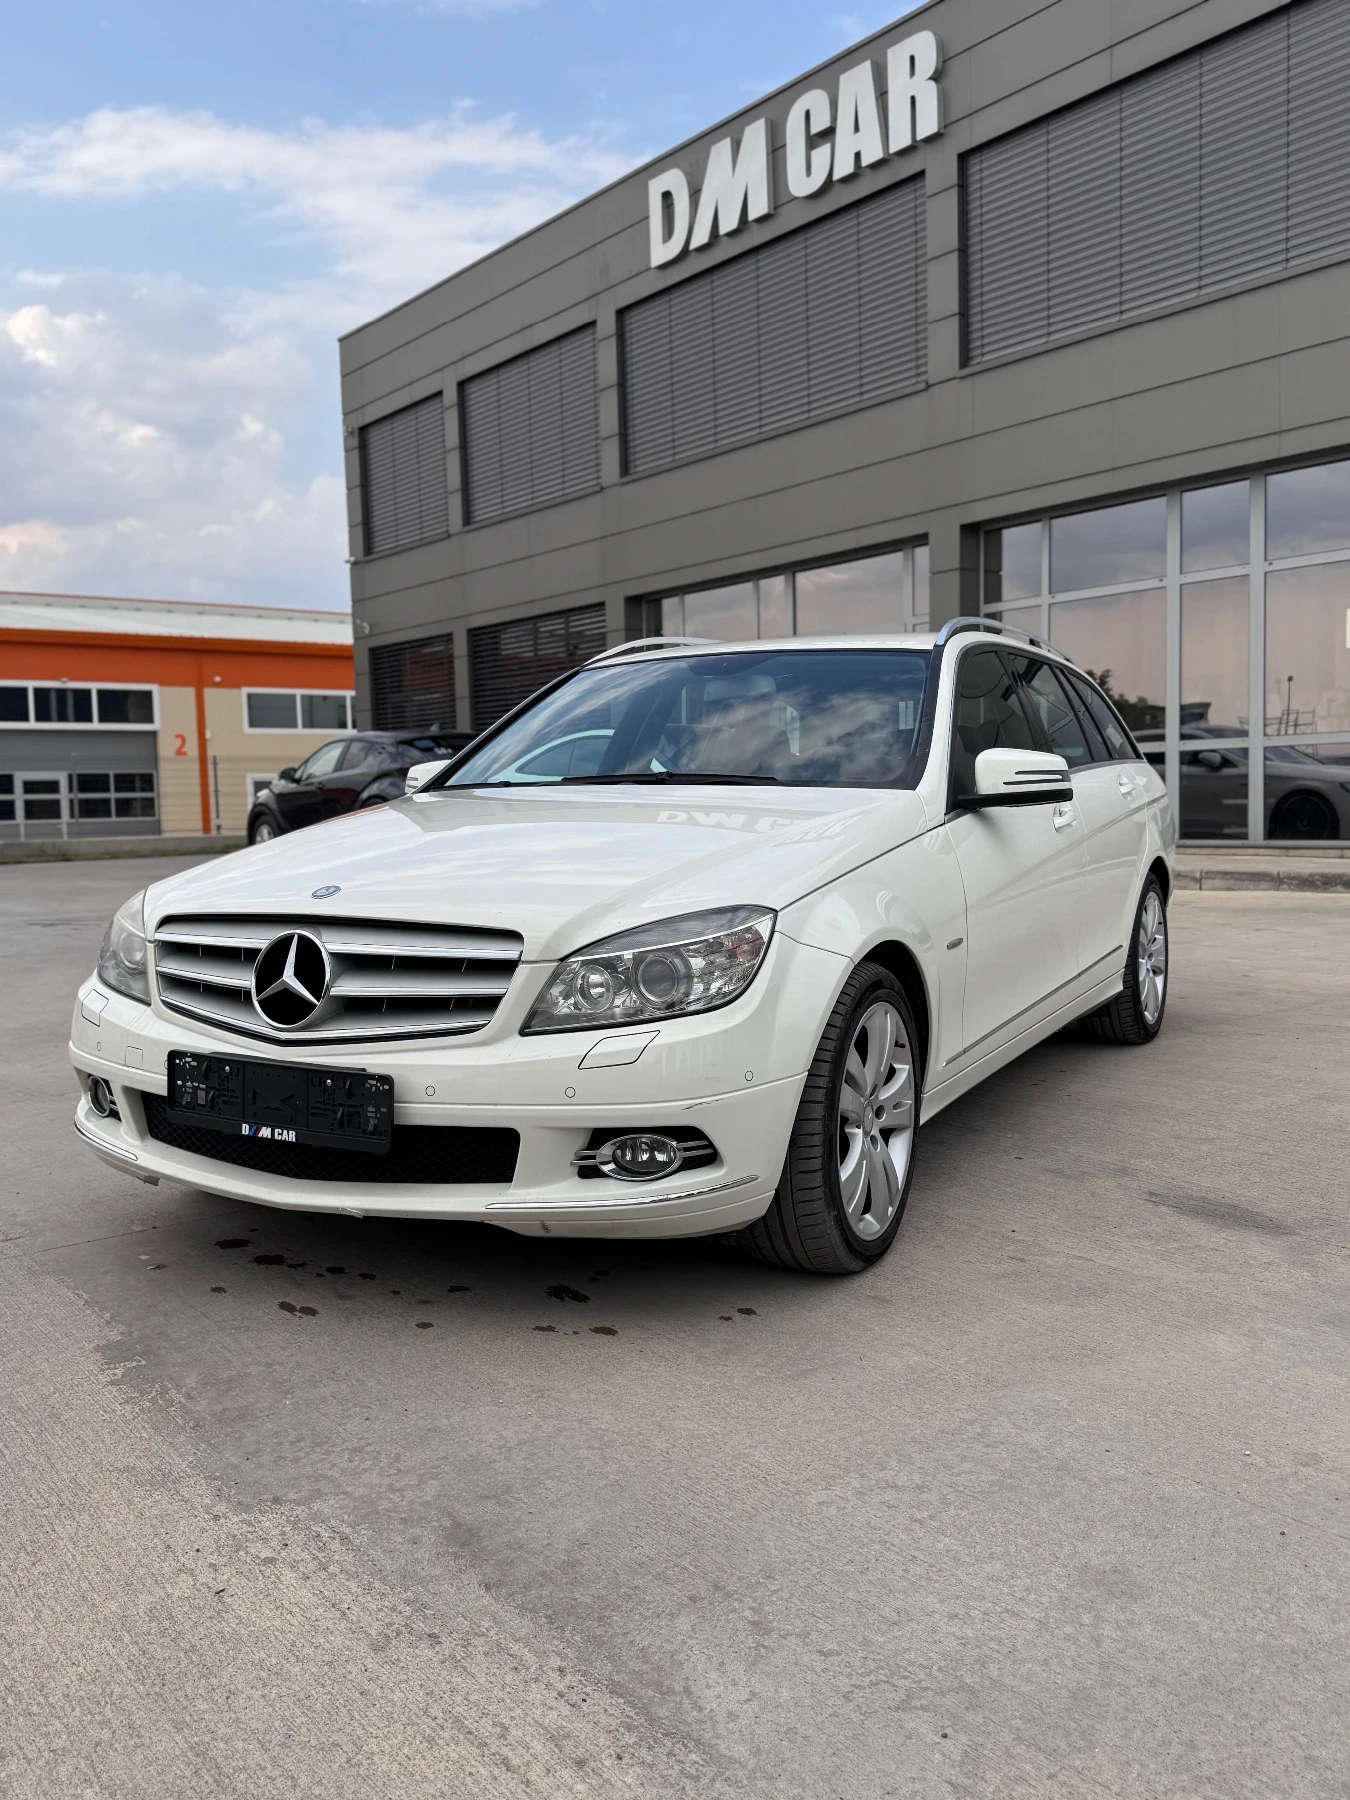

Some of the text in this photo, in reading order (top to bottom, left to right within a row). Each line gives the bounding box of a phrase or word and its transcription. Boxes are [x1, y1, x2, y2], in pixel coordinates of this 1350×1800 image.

[648, 30, 944, 268] DM CAR
[174, 733, 189, 757] 2
[274, 1128, 297, 1142] CAR
